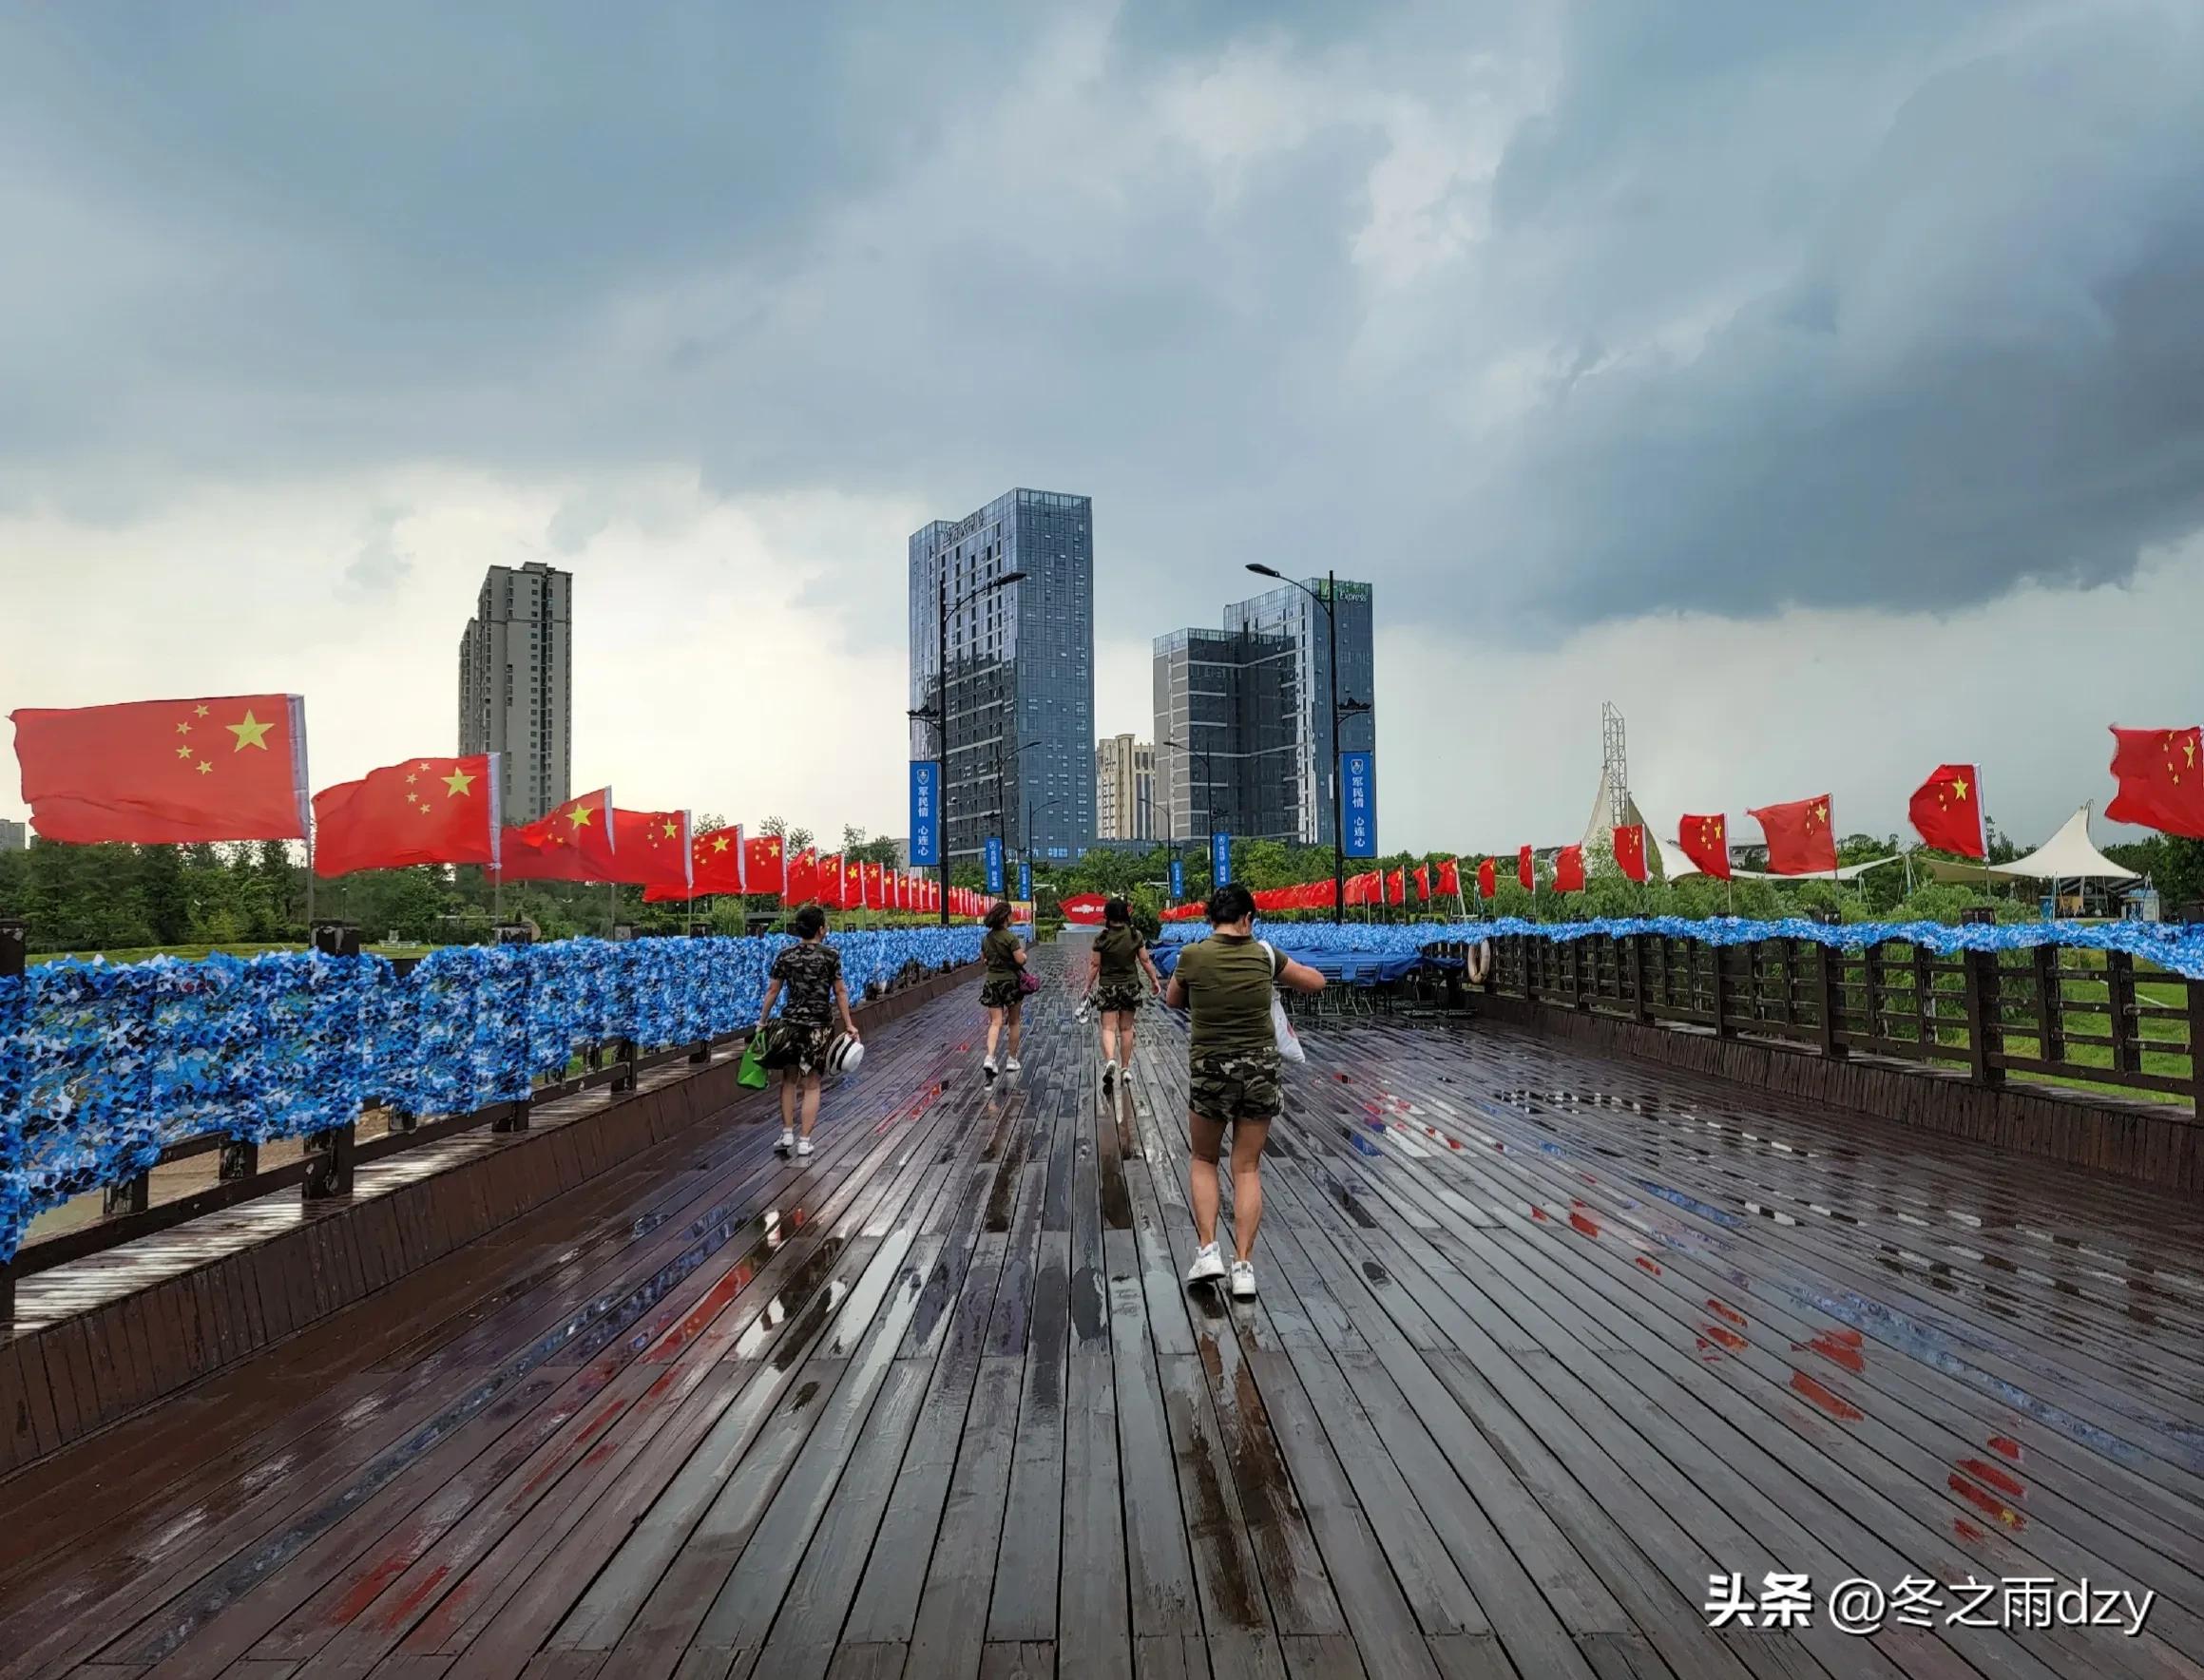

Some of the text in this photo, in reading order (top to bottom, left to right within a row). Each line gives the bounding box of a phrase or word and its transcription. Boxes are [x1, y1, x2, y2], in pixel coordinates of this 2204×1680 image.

[1340, 591, 1367, 602] Express
[917, 786, 929, 856] 军民情 心连心
[1352, 776, 1366, 848] 军民情 心连心
